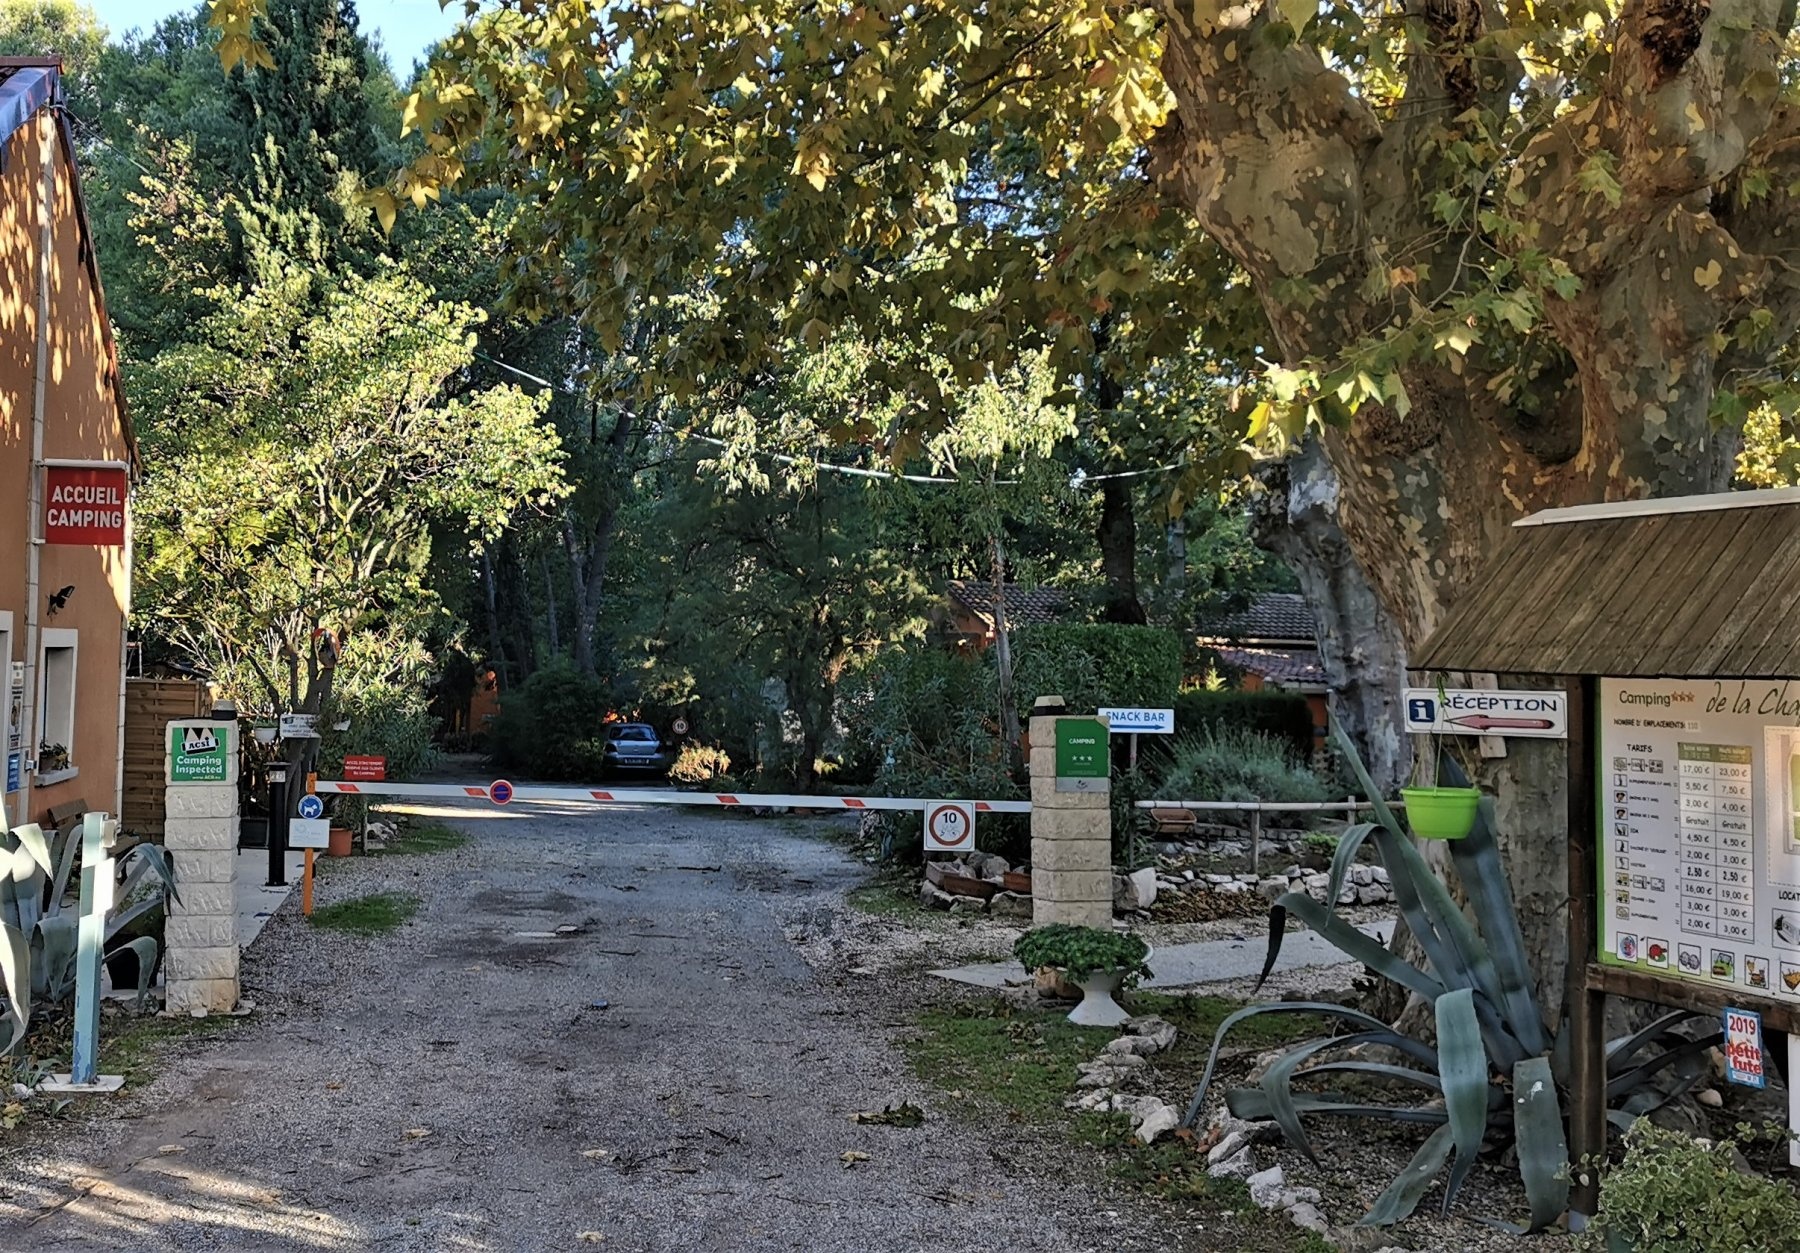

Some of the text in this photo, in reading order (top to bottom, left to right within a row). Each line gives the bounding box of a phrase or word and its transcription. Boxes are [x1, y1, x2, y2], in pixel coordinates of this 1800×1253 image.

[51, 485, 121, 505] ACCUEIL
[47, 508, 122, 528] CAMPING
[1441, 693, 1557, 712] RÉCEPTION
[1619, 690, 1671, 707] Camping
[1706, 680, 1800, 724] de la Cha
[1106, 711, 1165, 722] SNACK BAR
[1627, 744, 1653, 753] TARIFS
[175, 765, 223, 774] Inspected
[176, 756, 222, 766] Camping
[942, 812, 957, 823] 10
[1729, 1015, 1756, 1035] 2019
[1727, 1042, 1762, 1061] petit
